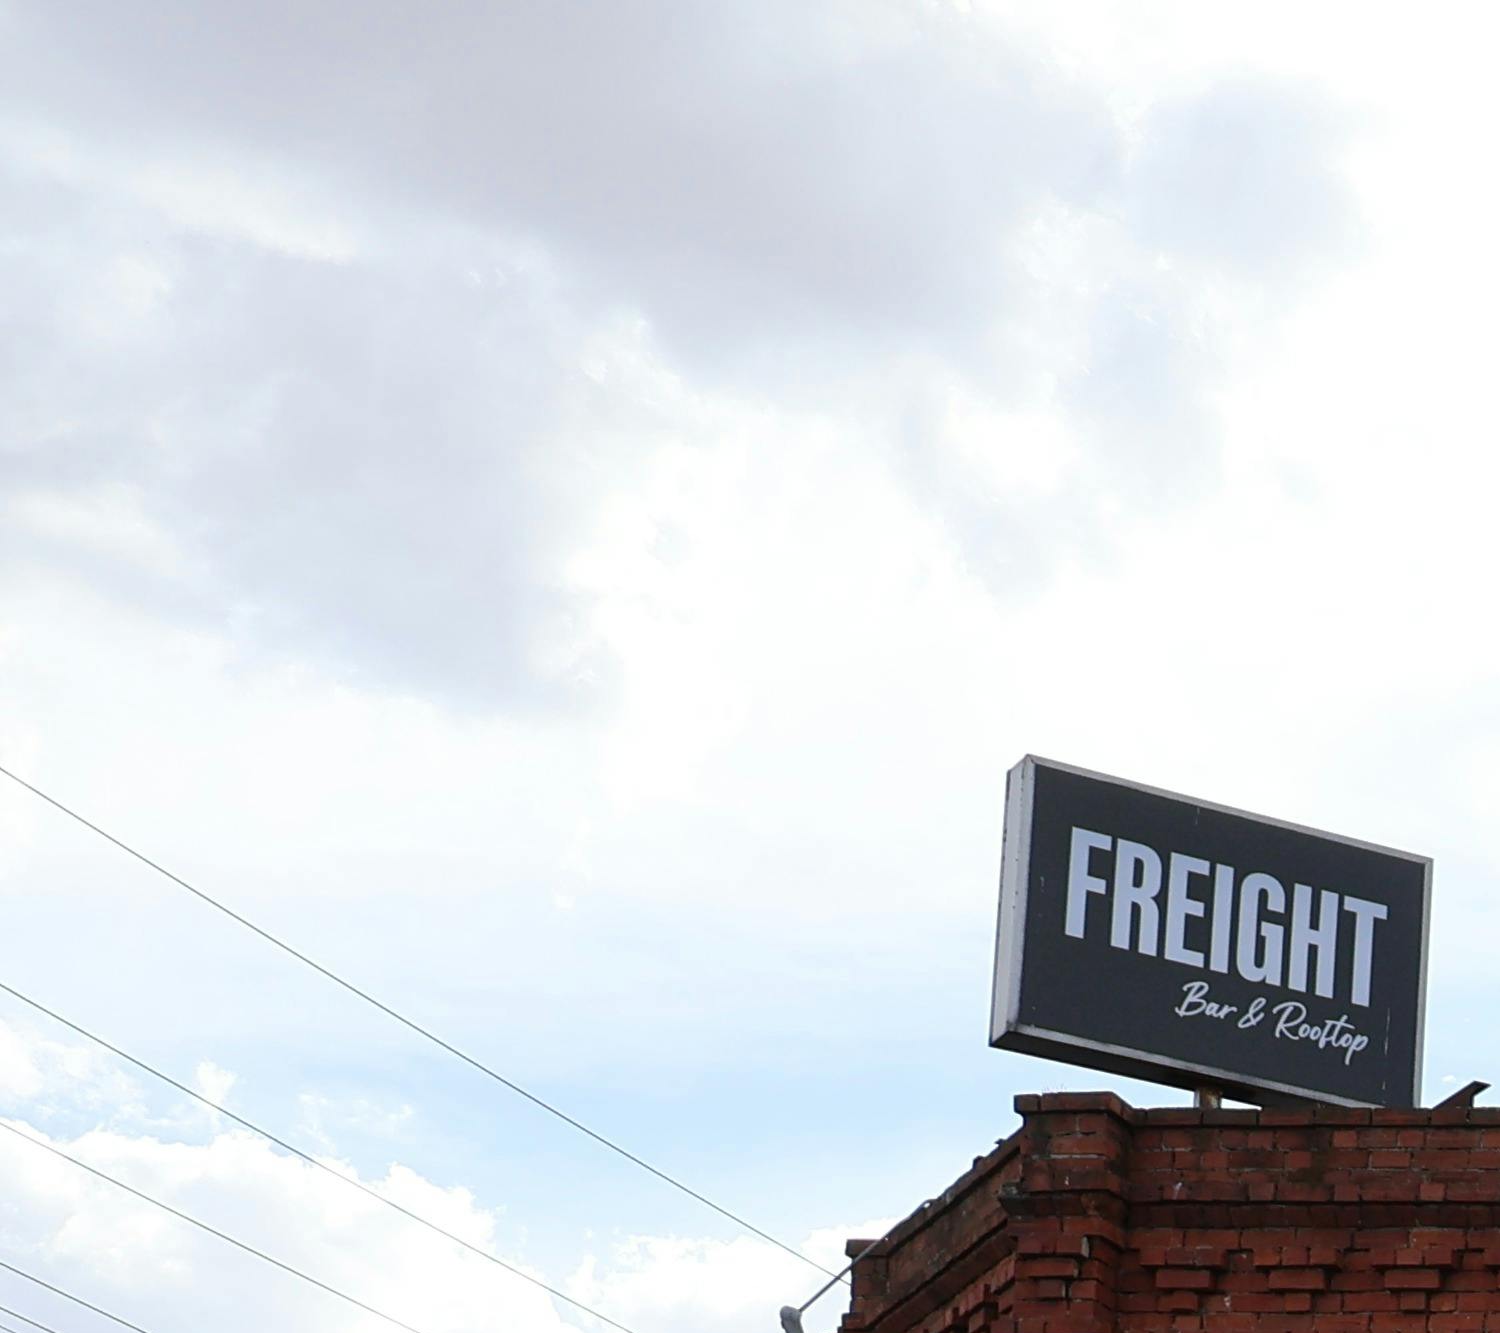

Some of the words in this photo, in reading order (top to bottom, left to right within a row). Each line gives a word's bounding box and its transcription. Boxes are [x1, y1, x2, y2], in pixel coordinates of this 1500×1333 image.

[1065, 826, 1388, 1007] FREIGHT
[1174, 981, 1238, 1018] Bar
[1237, 997, 1267, 1029] &
[1272, 1001, 1370, 1065] Rooftop
